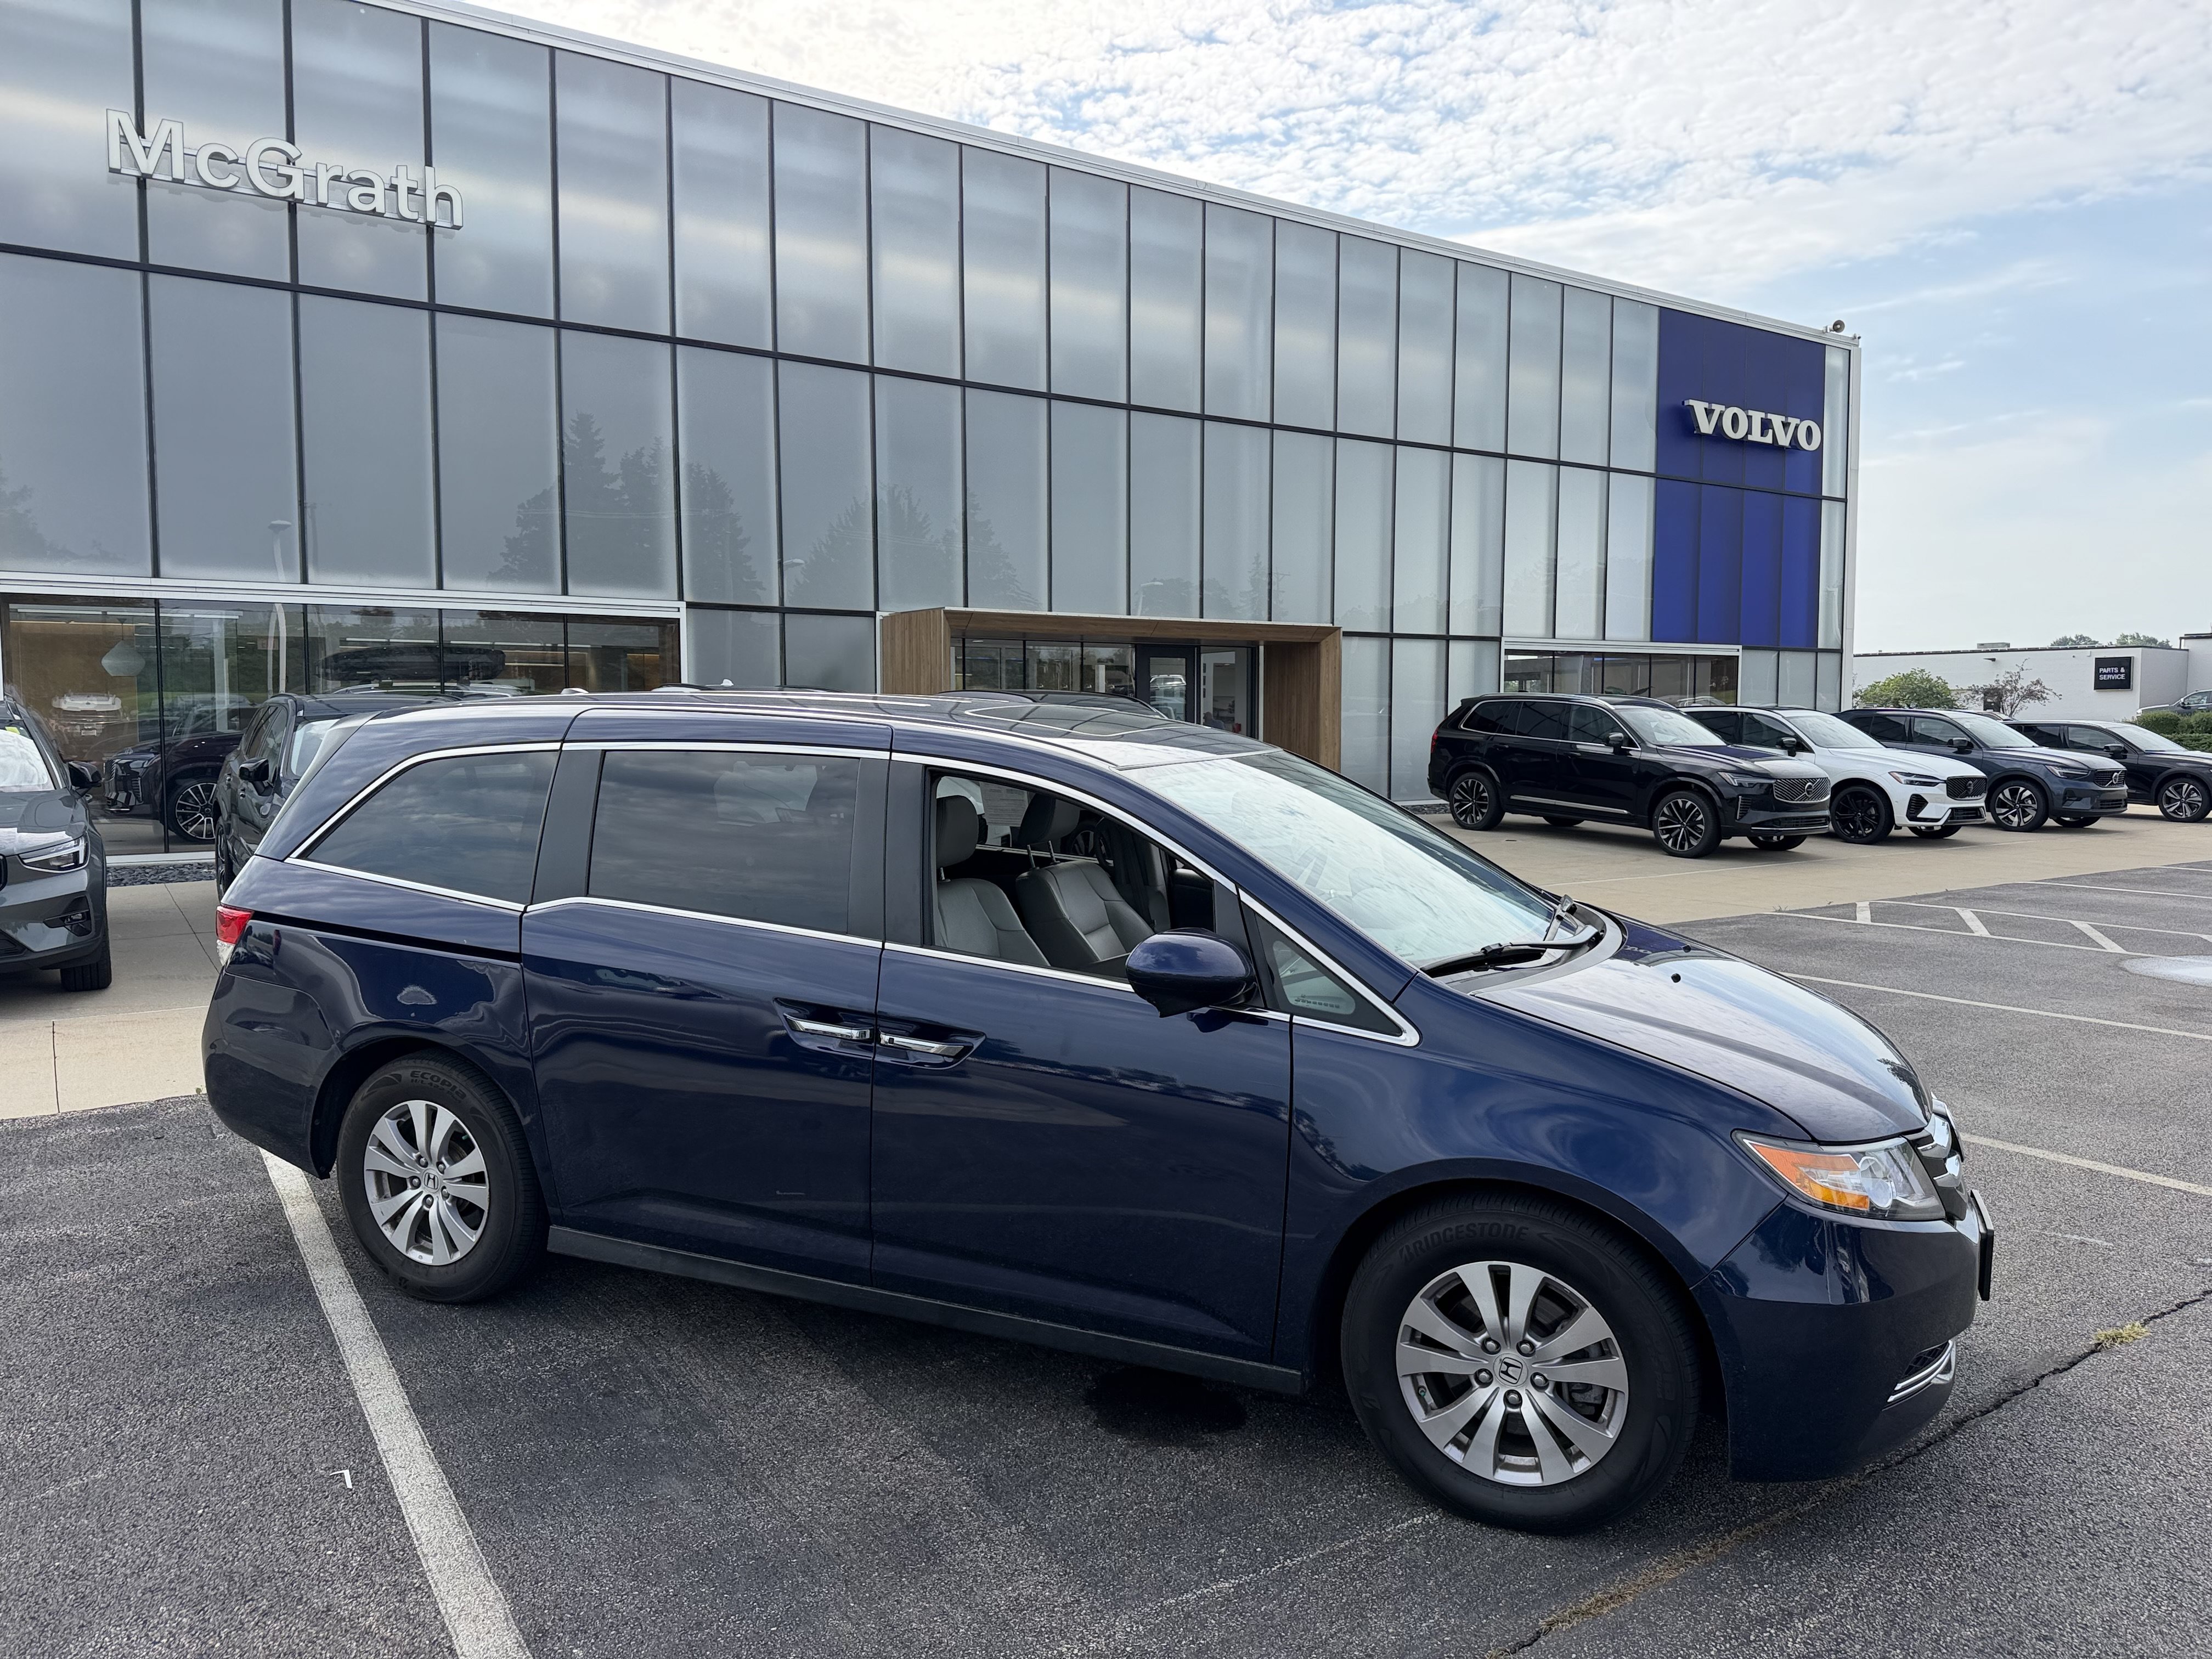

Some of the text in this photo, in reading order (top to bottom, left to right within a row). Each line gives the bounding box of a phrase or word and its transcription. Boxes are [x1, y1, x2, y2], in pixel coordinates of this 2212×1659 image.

[106, 109, 463, 230] McGrath
[1682, 399, 1821, 451] VOLVO
[1398, 1222, 1530, 1264] BRIDGESTONE
